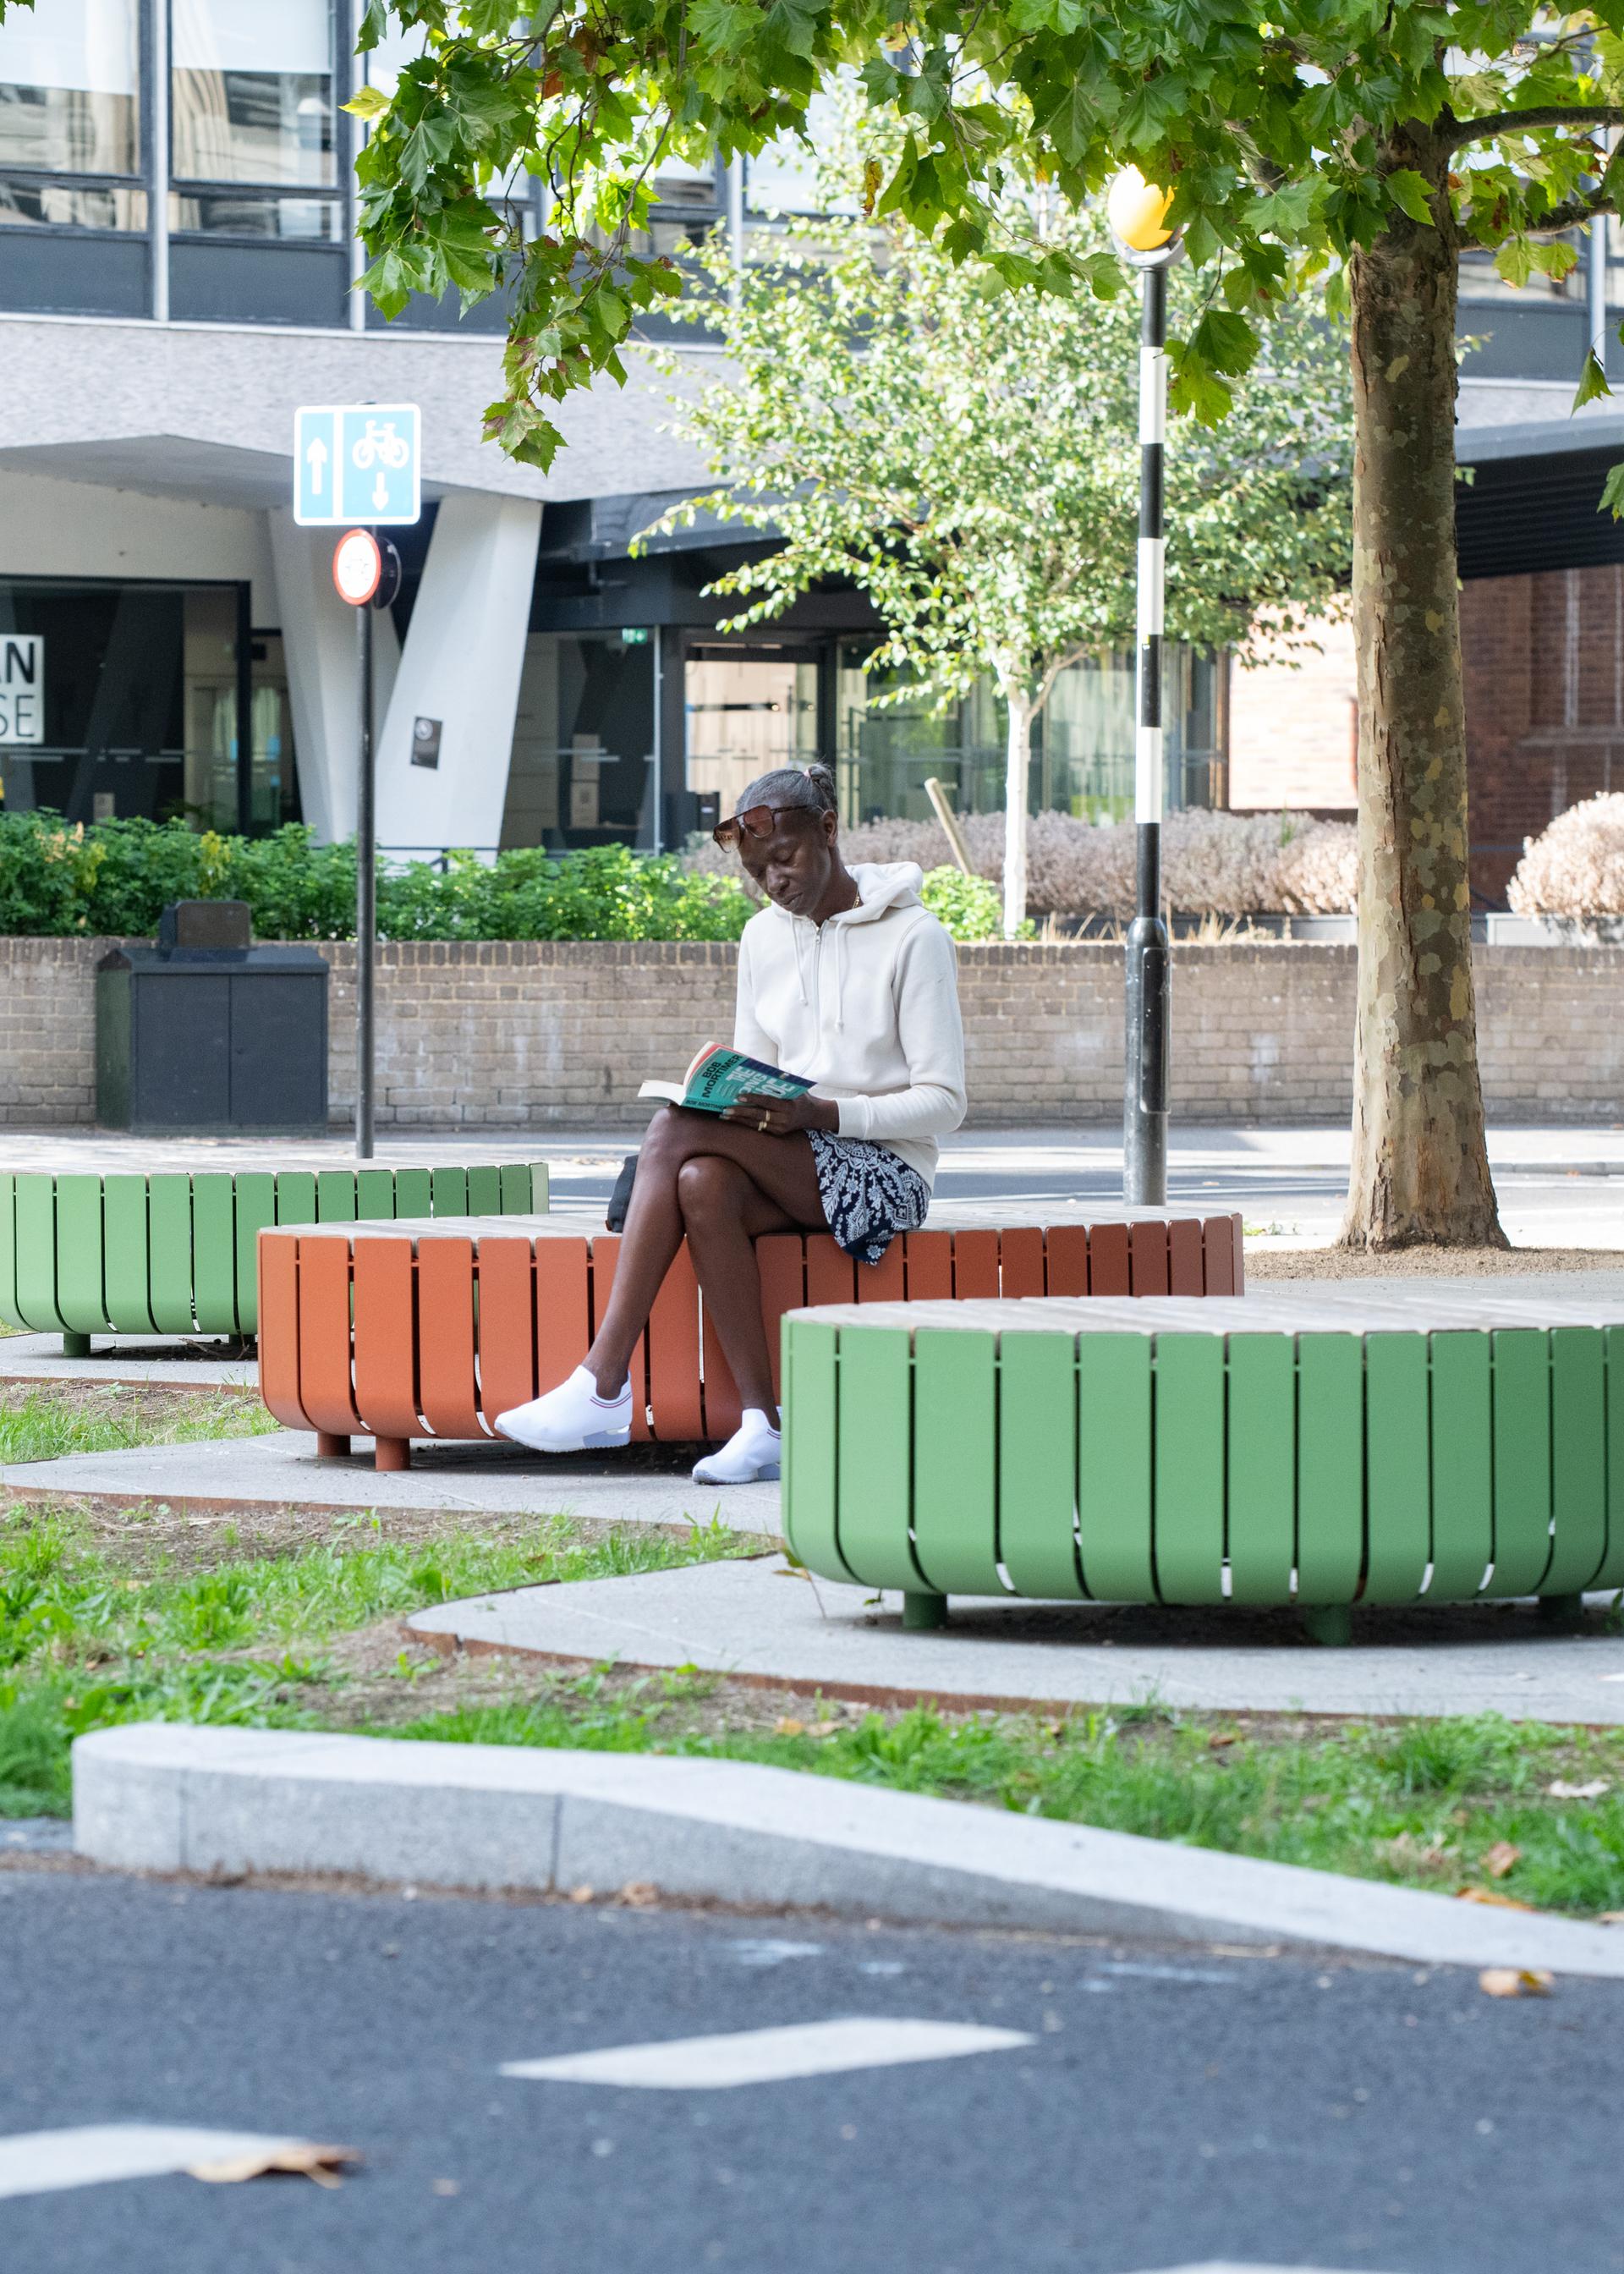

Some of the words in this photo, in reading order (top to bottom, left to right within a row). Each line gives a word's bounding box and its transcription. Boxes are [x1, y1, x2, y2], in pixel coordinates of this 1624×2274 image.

[0, 642, 35, 684] N
[701, 1061, 721, 1079] BOB
[702, 1054, 743, 1098] MORTIMER
[725, 1065, 754, 1082] THE
[738, 1073, 767, 1094] ONG
